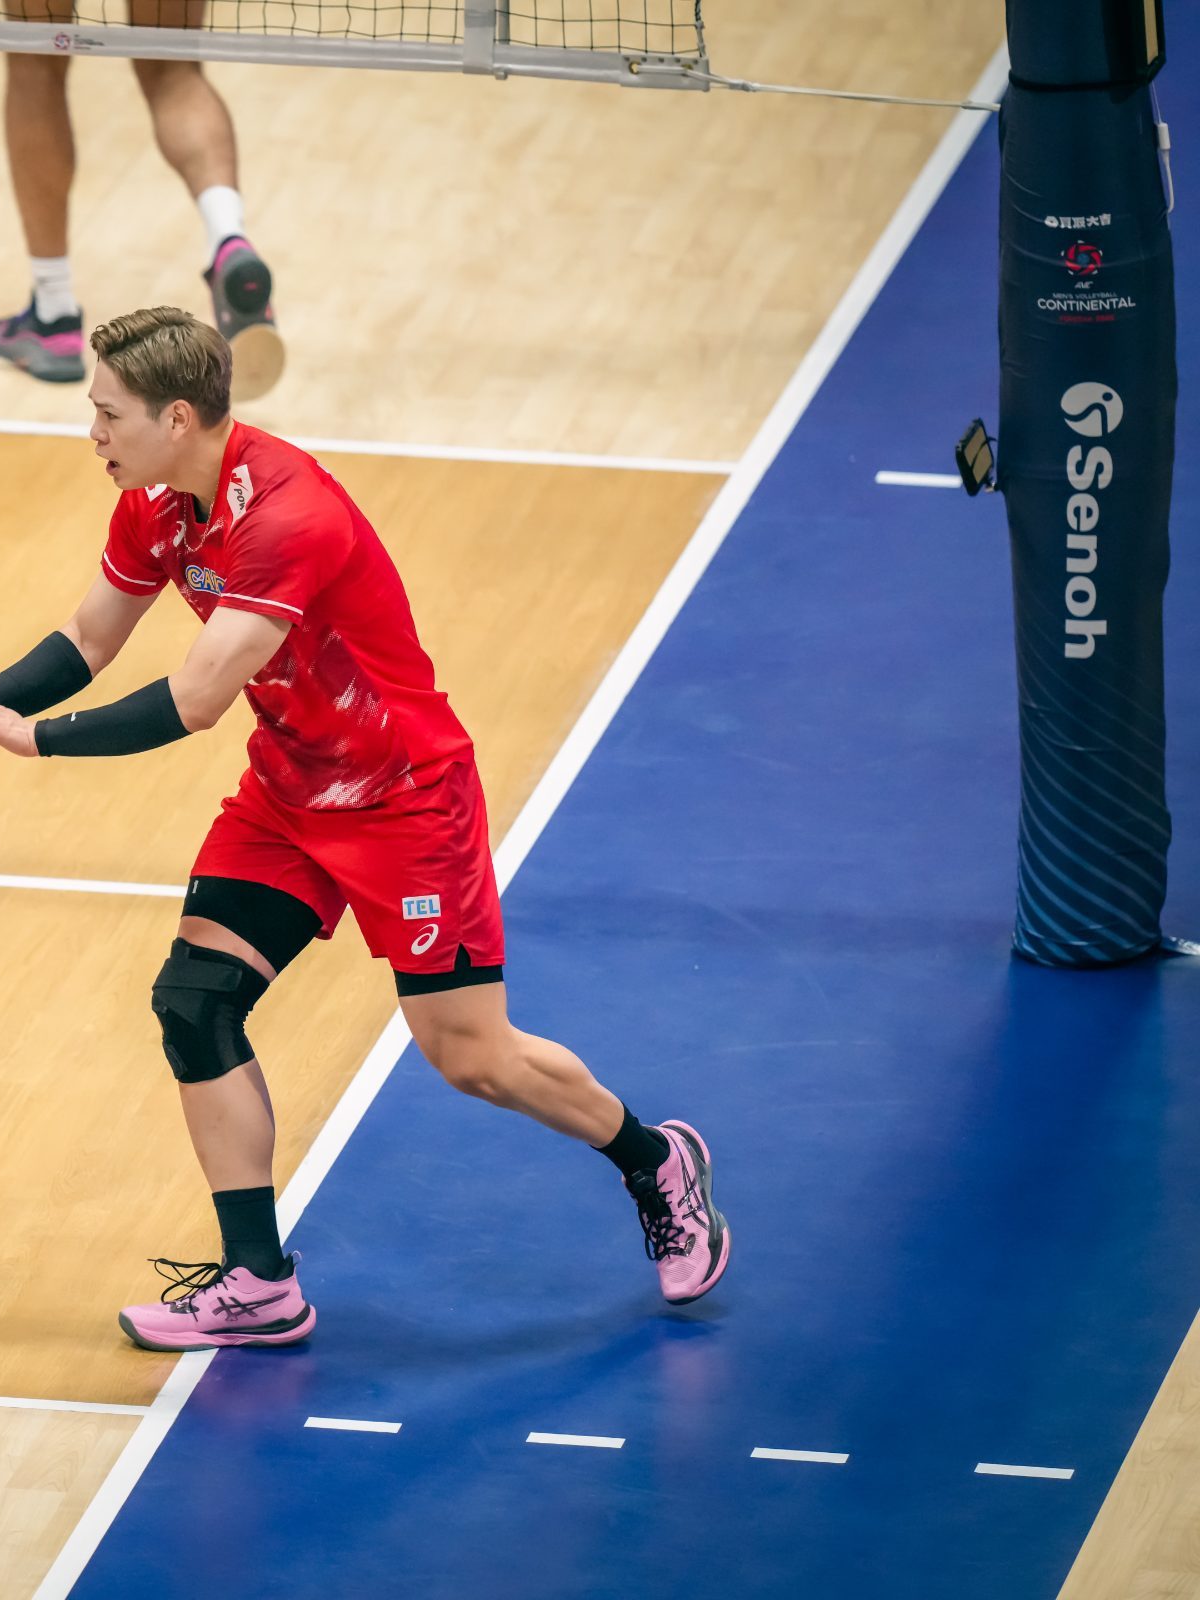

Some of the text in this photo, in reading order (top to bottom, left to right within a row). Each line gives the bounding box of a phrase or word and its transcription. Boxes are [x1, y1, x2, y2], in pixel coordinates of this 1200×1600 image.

[1037, 296, 1136, 312] CONTINENTAL
[1064, 444, 1114, 660] Senoh
[403, 898, 440, 916] TEL
